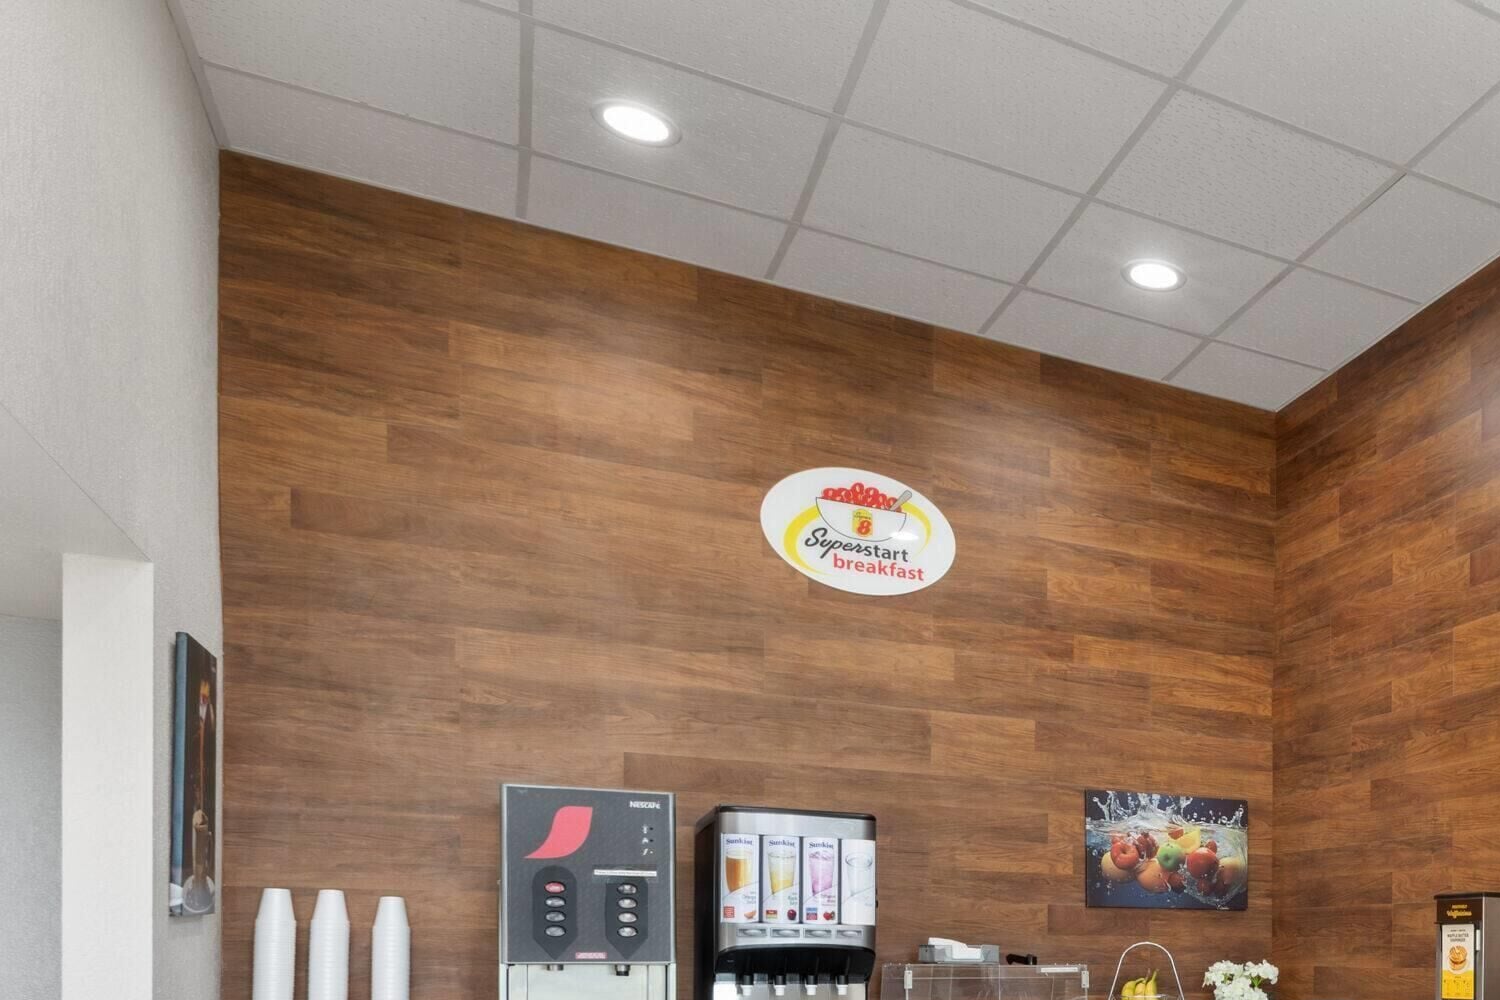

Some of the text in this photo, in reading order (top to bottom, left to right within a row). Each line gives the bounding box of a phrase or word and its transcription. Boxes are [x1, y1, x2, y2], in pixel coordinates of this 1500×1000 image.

[804, 527, 909, 562] Superstart
[832, 553, 924, 581] breakfast
[726, 837, 753, 846] Sunkist
[768, 839, 796, 848] Sunkist
[809, 841, 834, 850] Sunkist
